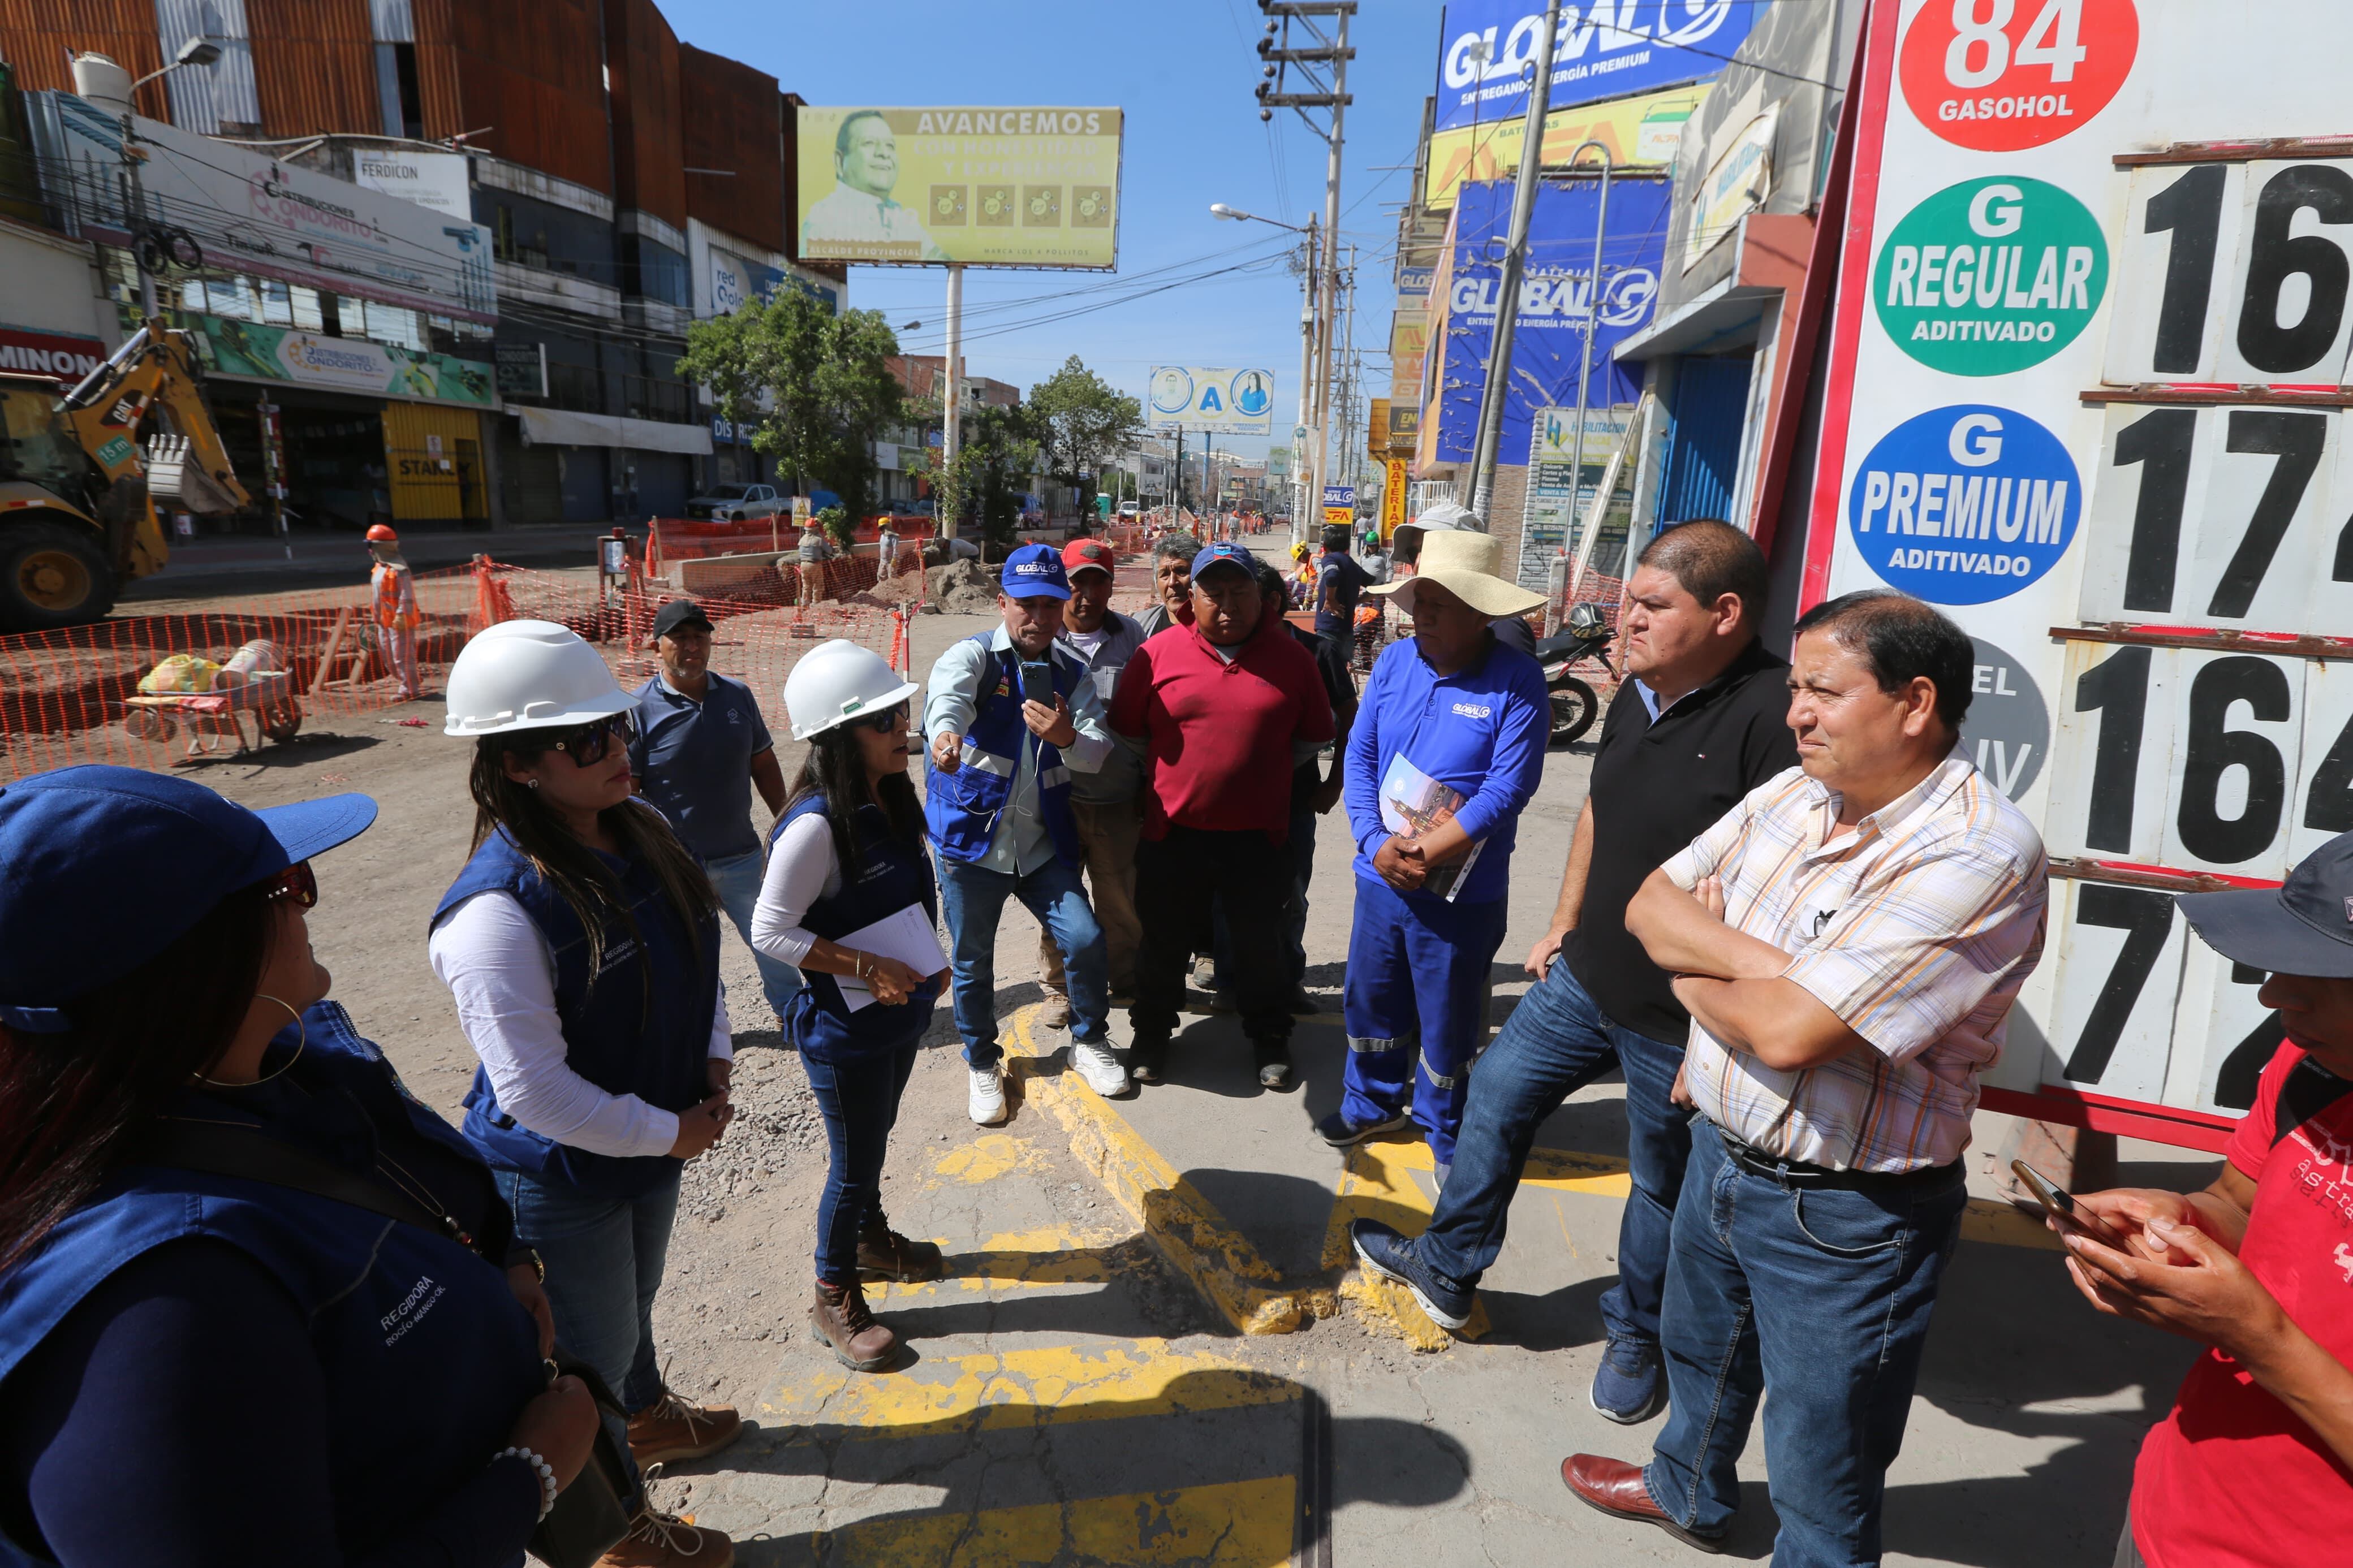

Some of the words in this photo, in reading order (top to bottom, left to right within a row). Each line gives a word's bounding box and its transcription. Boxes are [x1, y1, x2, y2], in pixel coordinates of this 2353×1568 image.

[1445, 0, 1652, 89] GLOBAL
[1945, 0, 2087, 89] 84
[1591, 50, 1650, 77] PREMIUM
[1938, 94, 2074, 121] GASOHOL
[917, 112, 1100, 135] AVANCEMOS
[1499, 120, 1559, 138] BATAS
[913, 140, 956, 155] CON
[964, 140, 1098, 156] HONESTIDAD
[361, 163, 418, 179] FERDICON
[943, 162, 955, 176] Y
[963, 162, 1098, 177] EXPERIENCIA
[1969, 184, 2023, 237] G
[809, 245, 852, 254] ALCALDE
[857, 247, 920, 256] PROVINCIAL
[717, 268, 735, 287] red
[1886, 245, 2093, 310] REGULAR
[2144, 163, 2353, 375] 16
[1450, 278, 1594, 317] GLBAL
[1467, 317, 1520, 327] ENTREO
[1523, 318, 1558, 327] ENERGÍA
[1911, 320, 2056, 342] ADITIVADO
[113, 398, 134, 422] CAT
[1199, 387, 1222, 411] A
[98, 444, 117, 460] 15
[115, 440, 130, 452] m
[1949, 414, 2003, 468] G
[1389, 463, 1402, 529] BATERIAS
[1860, 470, 2068, 546] PREMIUM
[2113, 408, 2353, 619] 17
[1016, 564, 1048, 572] GLOBAL
[1889, 547, 2031, 578] ADITIVADO
[1453, 703, 1480, 715] GLOBAL
[380, 1276, 434, 1332] REGIDORA
